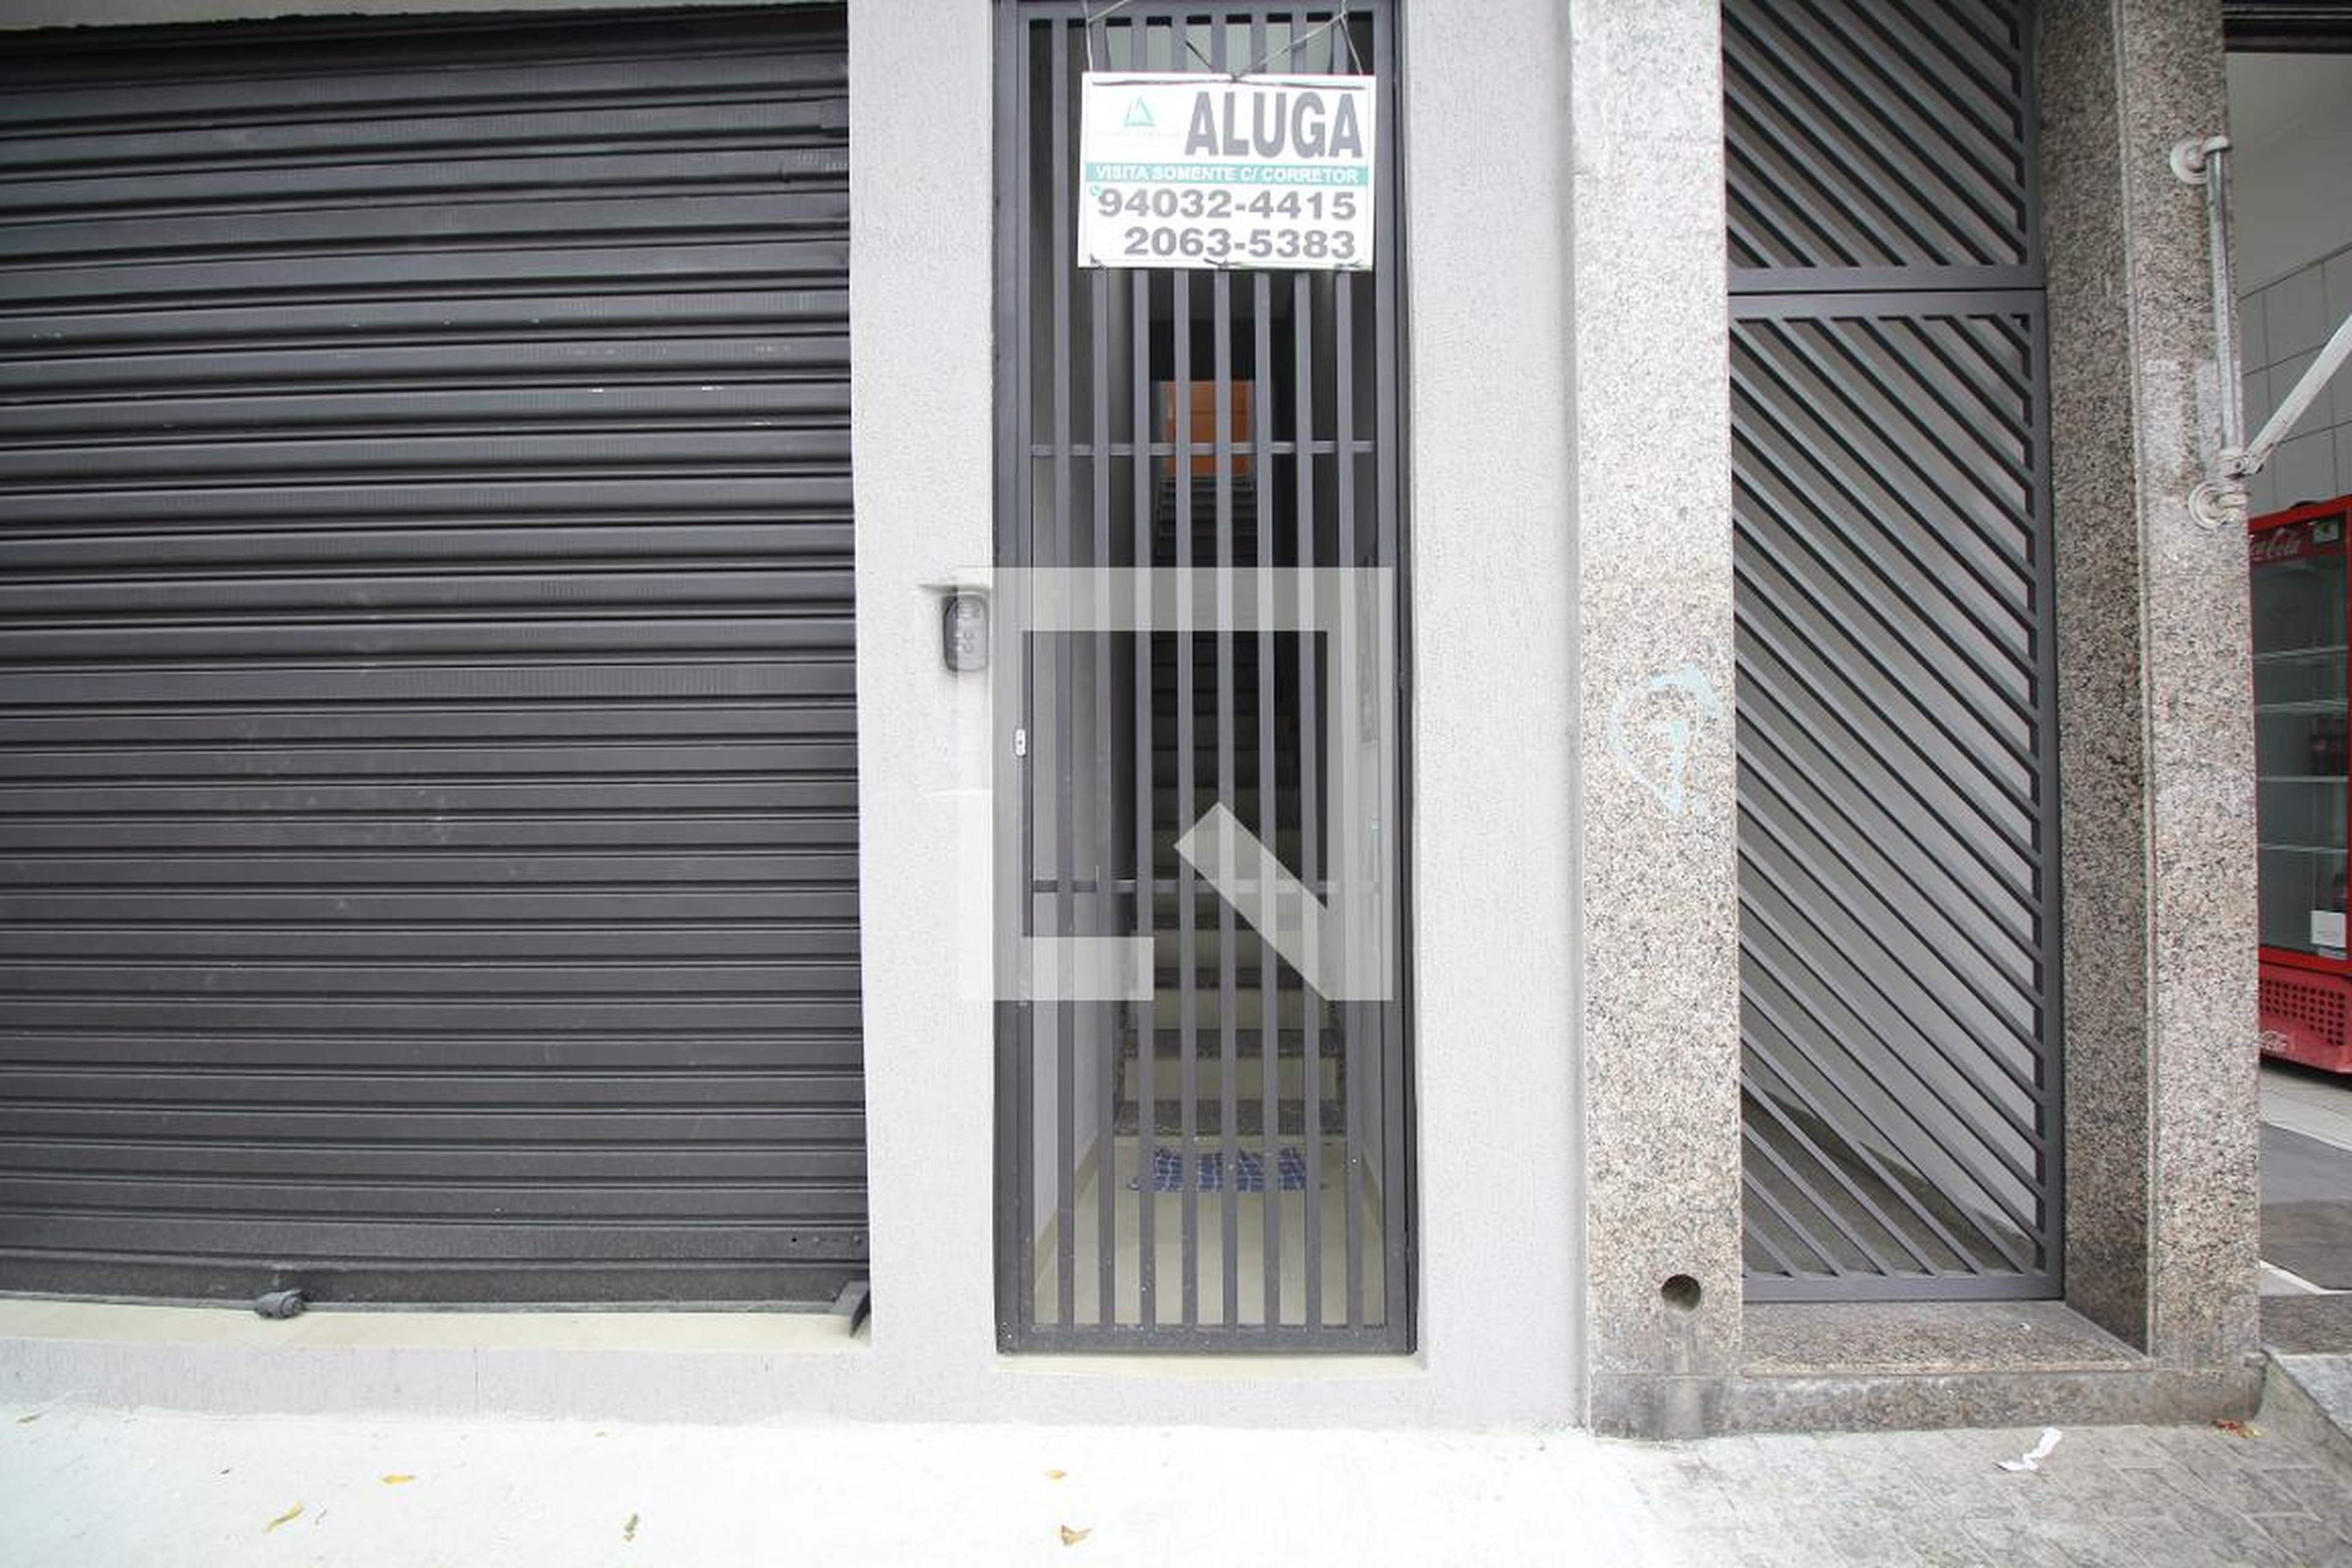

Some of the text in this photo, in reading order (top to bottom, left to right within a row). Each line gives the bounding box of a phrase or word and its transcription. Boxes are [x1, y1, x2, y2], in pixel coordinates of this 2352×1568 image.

[1184, 91, 1363, 159] ALUGA
[1095, 165, 1359, 183] VISITA SOMENTE C/ CORRETOR
[1098, 188, 1357, 221] 94032-4415
[1123, 225, 1355, 260] 2063-5383
